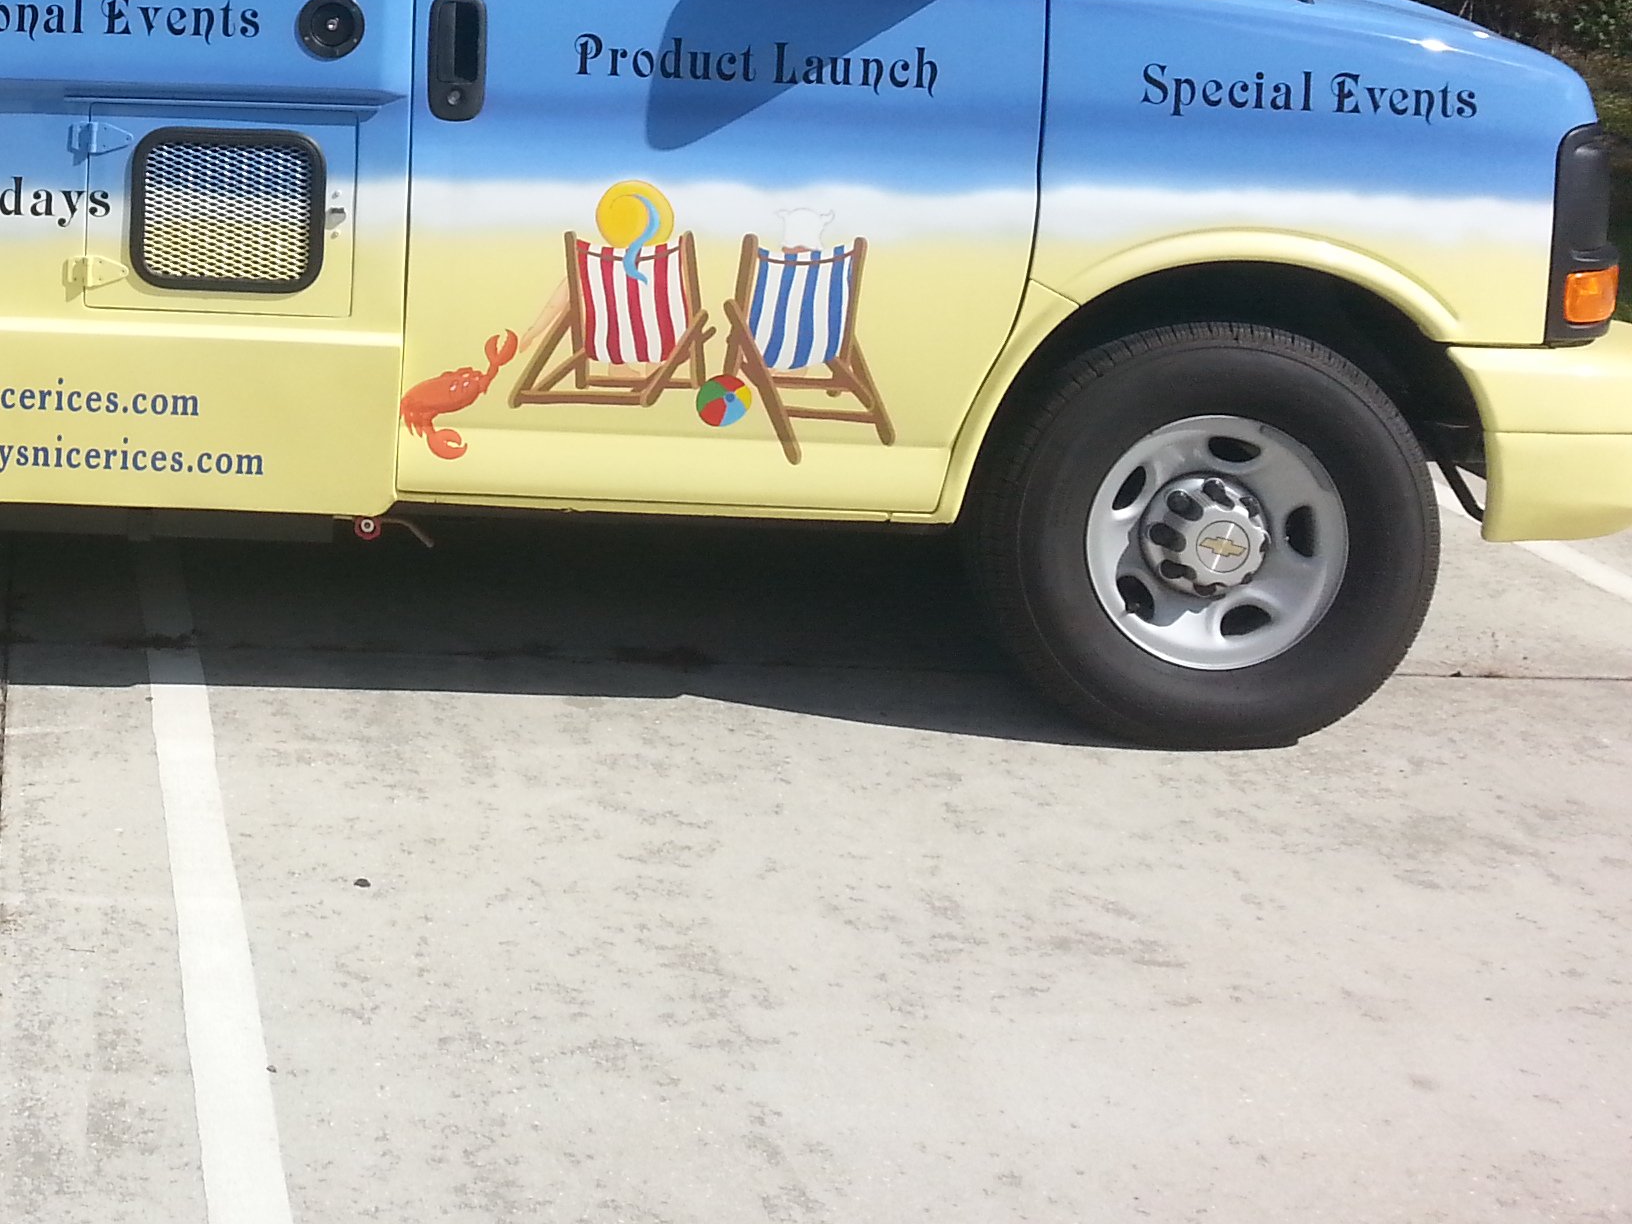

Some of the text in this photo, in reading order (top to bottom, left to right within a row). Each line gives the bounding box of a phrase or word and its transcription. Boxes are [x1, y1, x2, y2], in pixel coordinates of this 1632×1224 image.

[574, 33, 938, 98] Product Launch
[1141, 63, 1477, 125] Special Events
